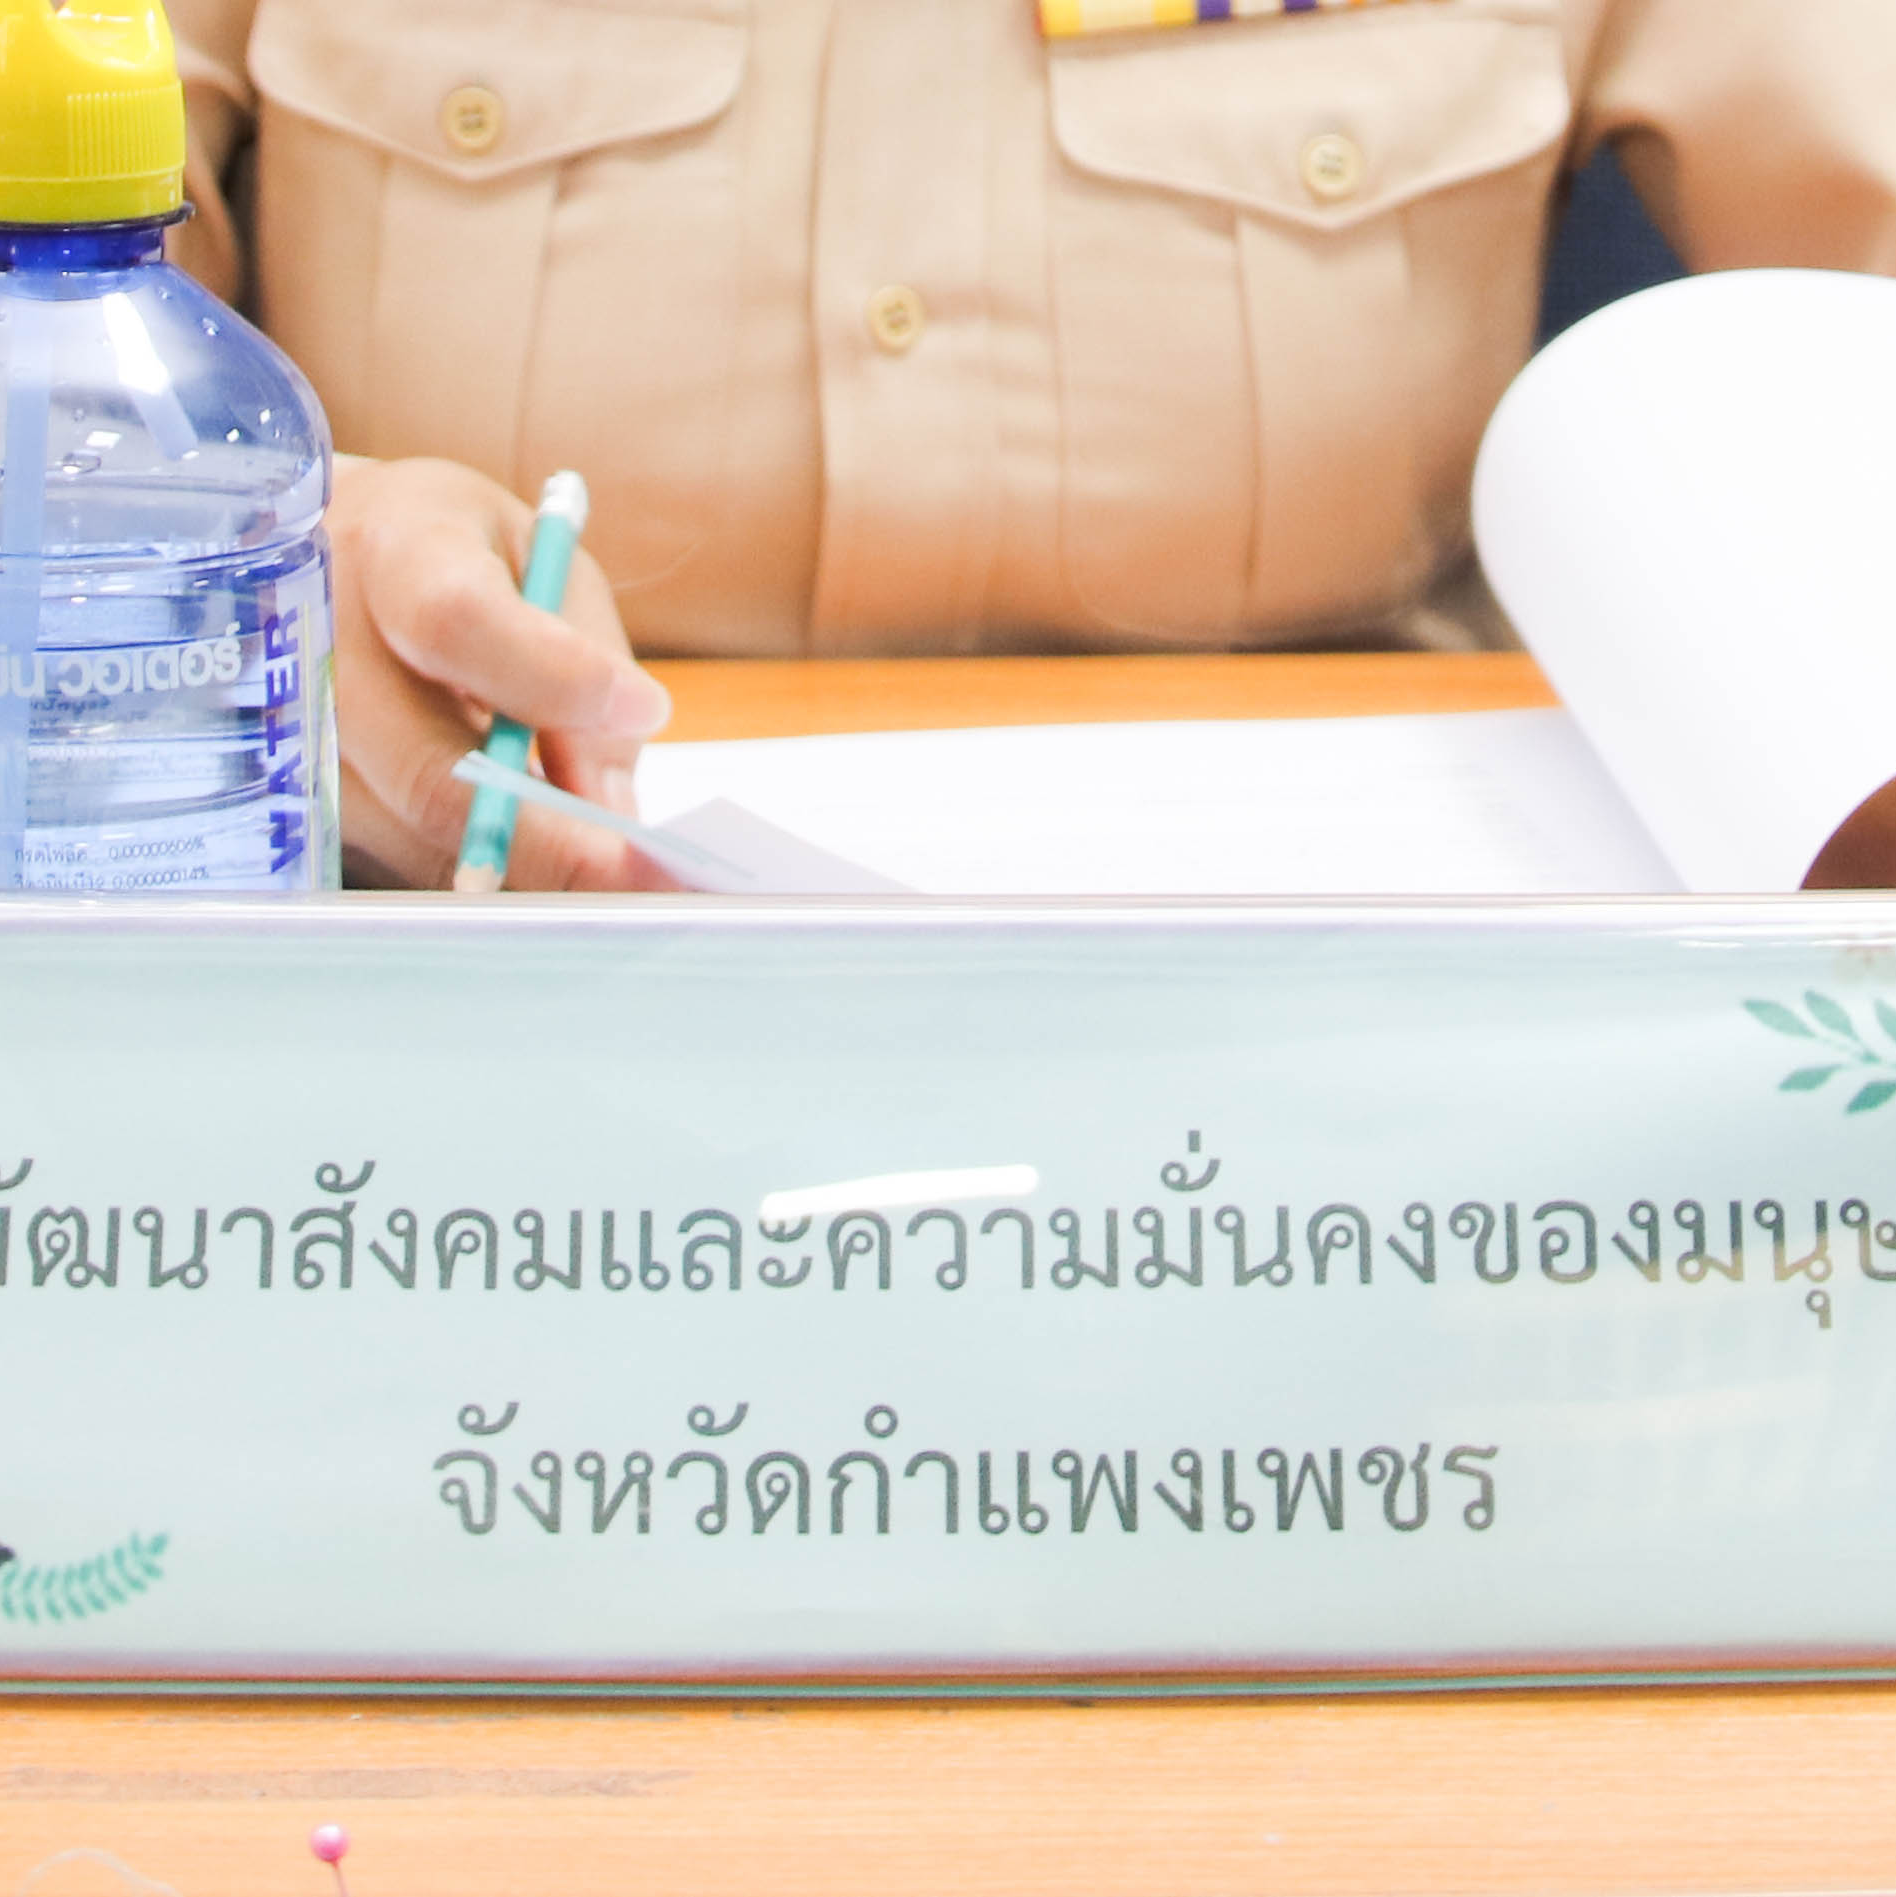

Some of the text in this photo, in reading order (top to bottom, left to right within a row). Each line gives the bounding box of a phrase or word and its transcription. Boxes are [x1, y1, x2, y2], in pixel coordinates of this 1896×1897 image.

[57, 622, 243, 698] วอเตอร์
[261, 606, 307, 876] WATER
[432, 1401, 1499, 1536] จังหวัดกำแพงเพชร
